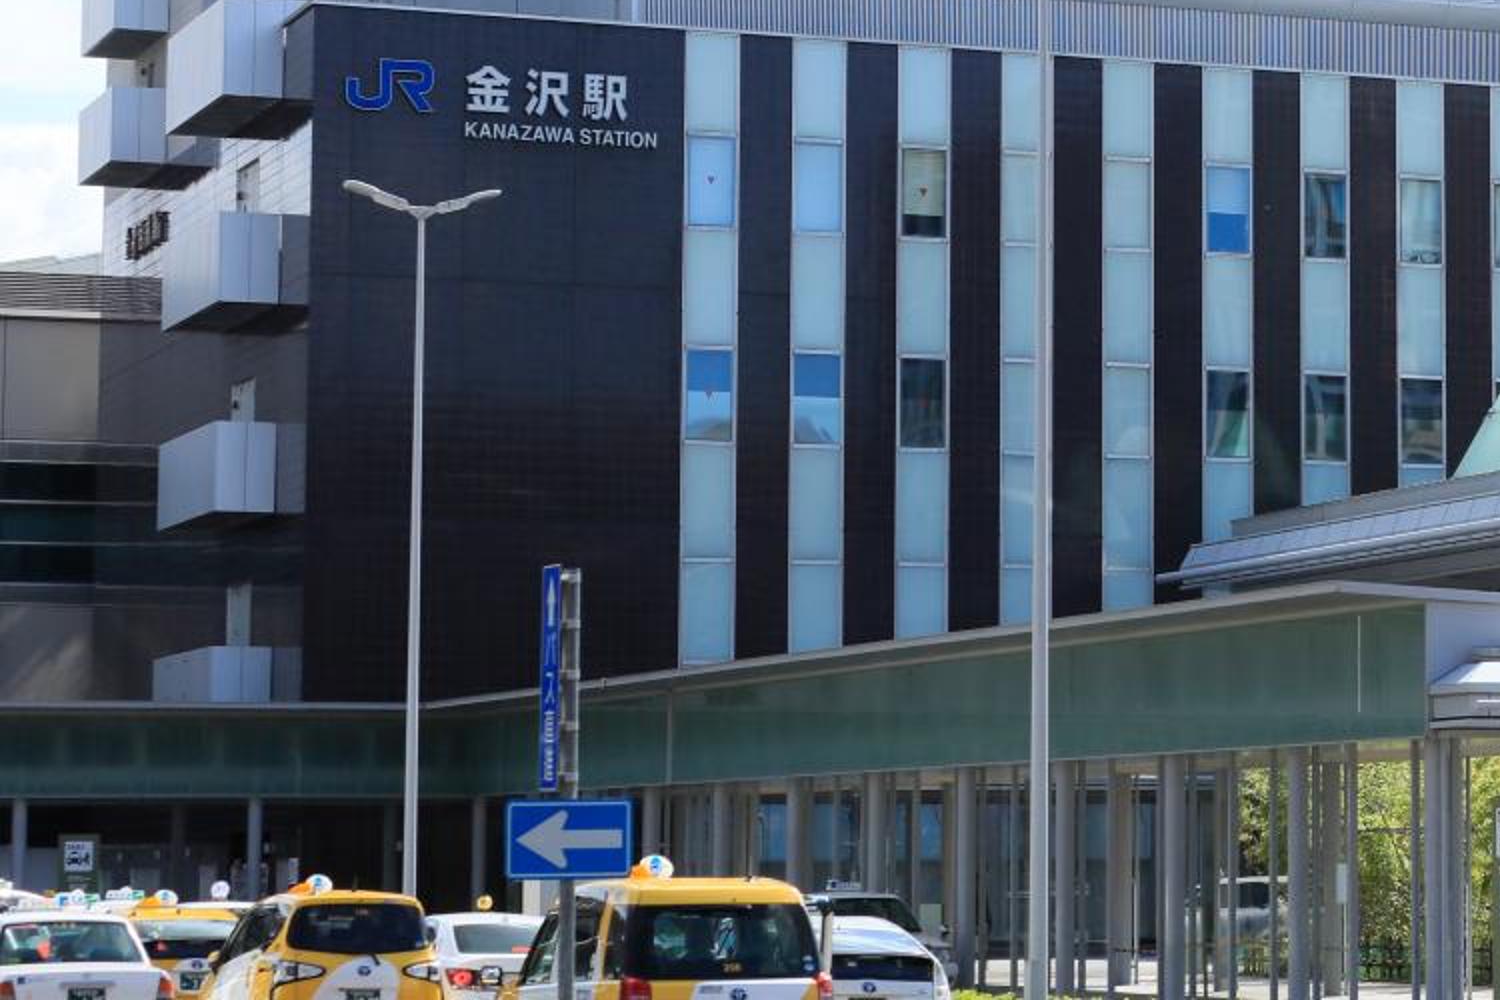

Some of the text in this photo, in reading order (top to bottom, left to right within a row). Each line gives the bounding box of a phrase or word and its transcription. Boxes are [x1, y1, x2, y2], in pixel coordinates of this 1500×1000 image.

[345, 57, 436, 113] JR
[464, 65, 628, 122] 金沢駅
[464, 121, 658, 149] KANAZAWA STATION
